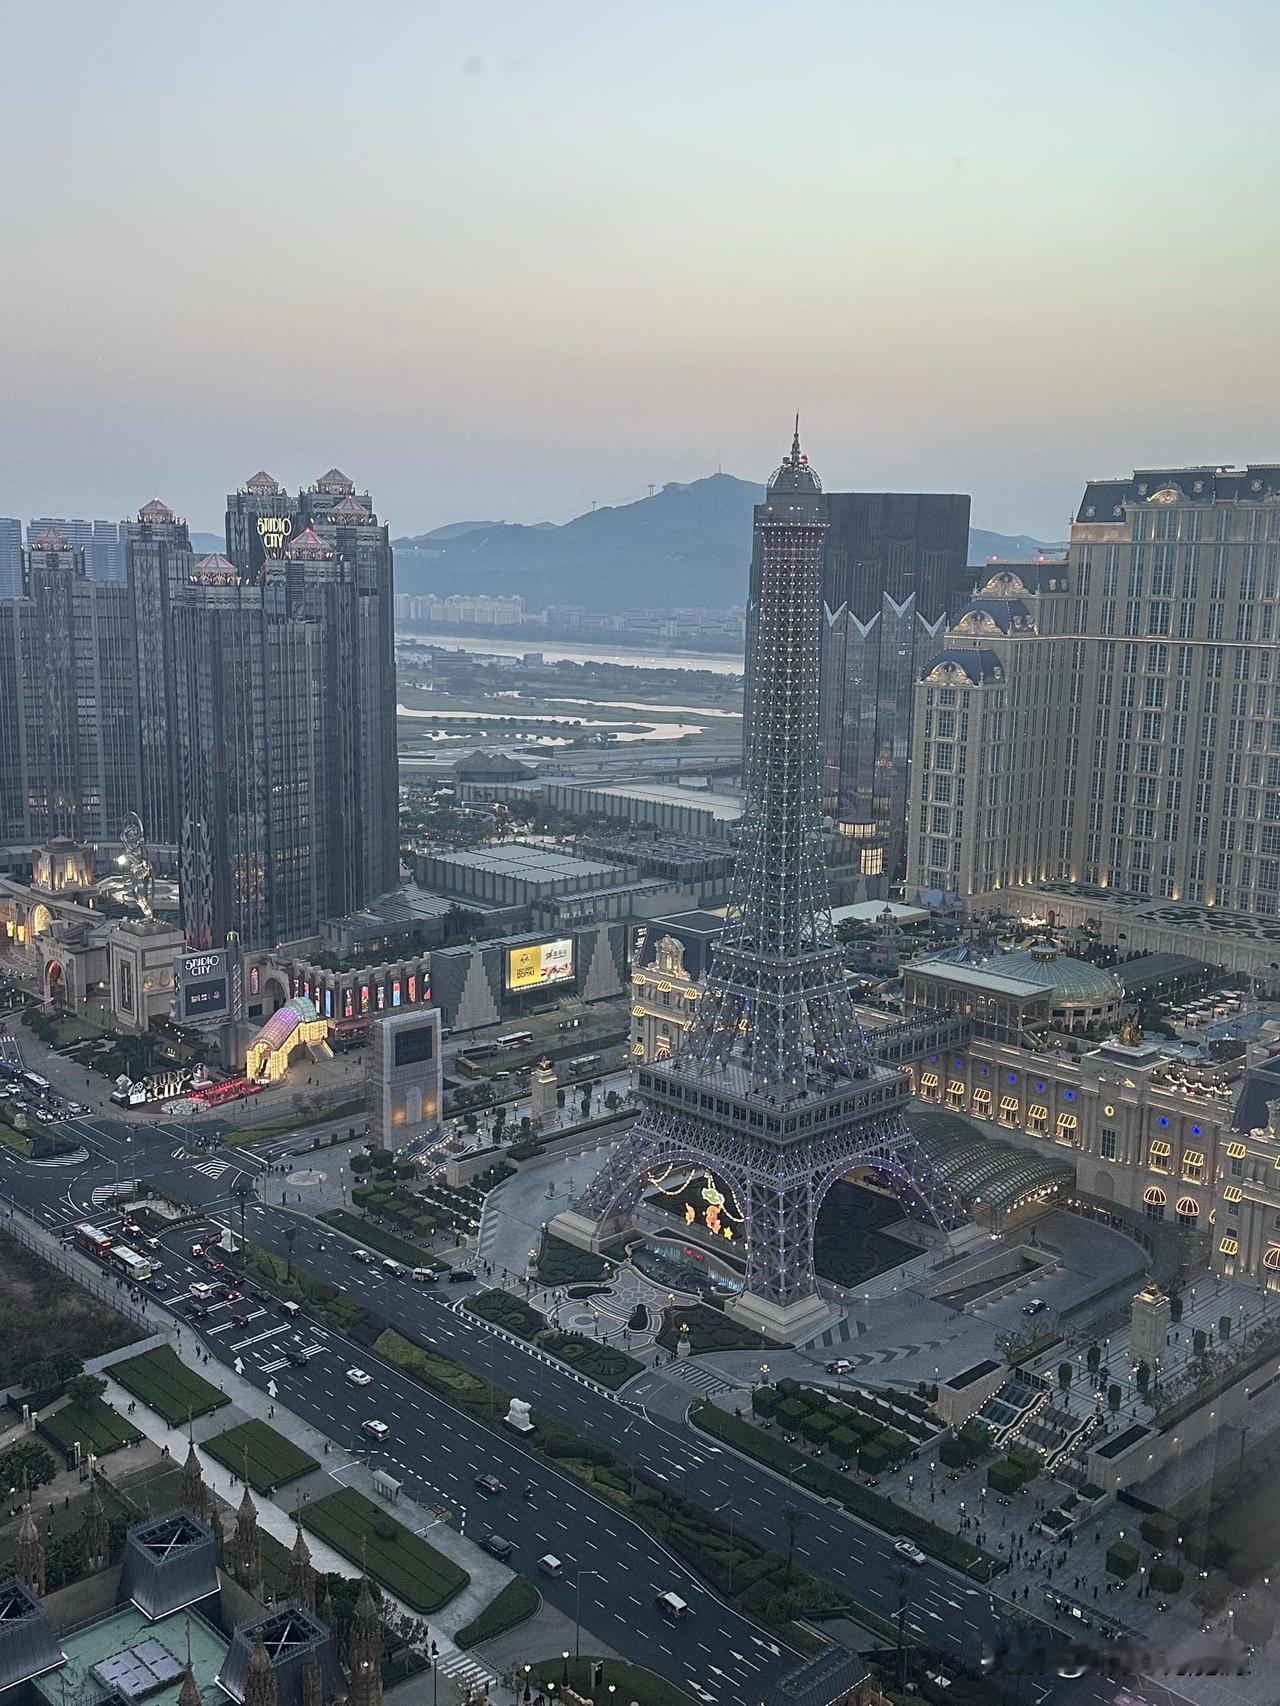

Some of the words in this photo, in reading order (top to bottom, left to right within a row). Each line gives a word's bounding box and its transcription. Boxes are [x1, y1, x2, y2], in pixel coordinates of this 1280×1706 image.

[257, 517, 292, 536] STUDIO
[264, 533, 283, 548] CITY
[185, 955, 219, 970] STUDIO
[192, 965, 211, 976] CITY
[143, 1068, 192, 1090] STUDIO
[154, 1080, 183, 1098] CITY
